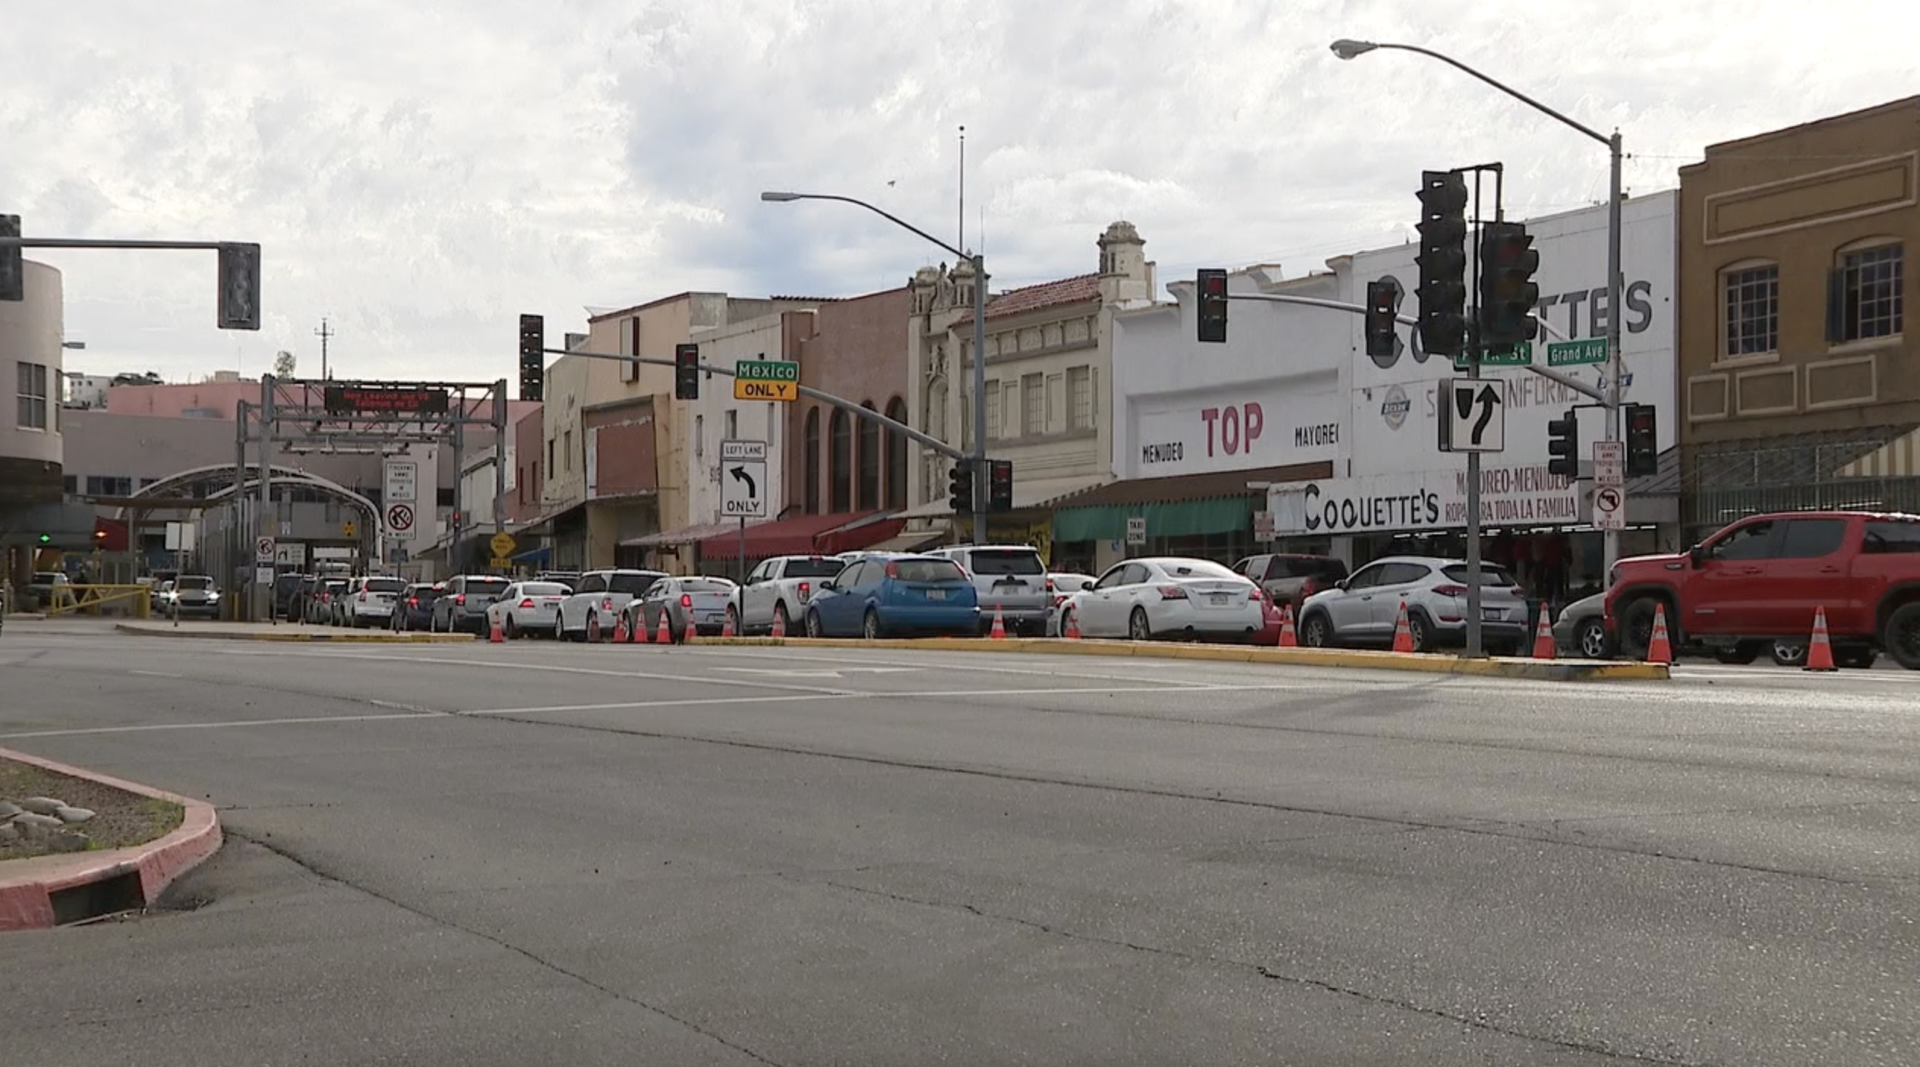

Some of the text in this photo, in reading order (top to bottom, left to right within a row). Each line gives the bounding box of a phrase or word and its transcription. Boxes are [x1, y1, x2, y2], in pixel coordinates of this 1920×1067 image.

[1551, 345, 1603, 362] Grand Ave
[739, 363, 796, 379] Mexico
[745, 383, 787, 397] ONLY
[1202, 402, 1263, 457] TOP
[726, 445, 762, 455] LEFT LANE
[1142, 442, 1183, 464] MENUDEO
[1456, 465, 1571, 496] MOREO-MENUDEO
[727, 500, 760, 512] ONLY
[1305, 483, 1439, 530] COQUETTE'S
[1495, 500, 1519, 520] TODA
[1520, 499, 1533, 519] LA
[1536, 496, 1576, 518] FAMILIA
[1129, 521, 1144, 530] TAXI
[1128, 532, 1145, 541] ZONE
